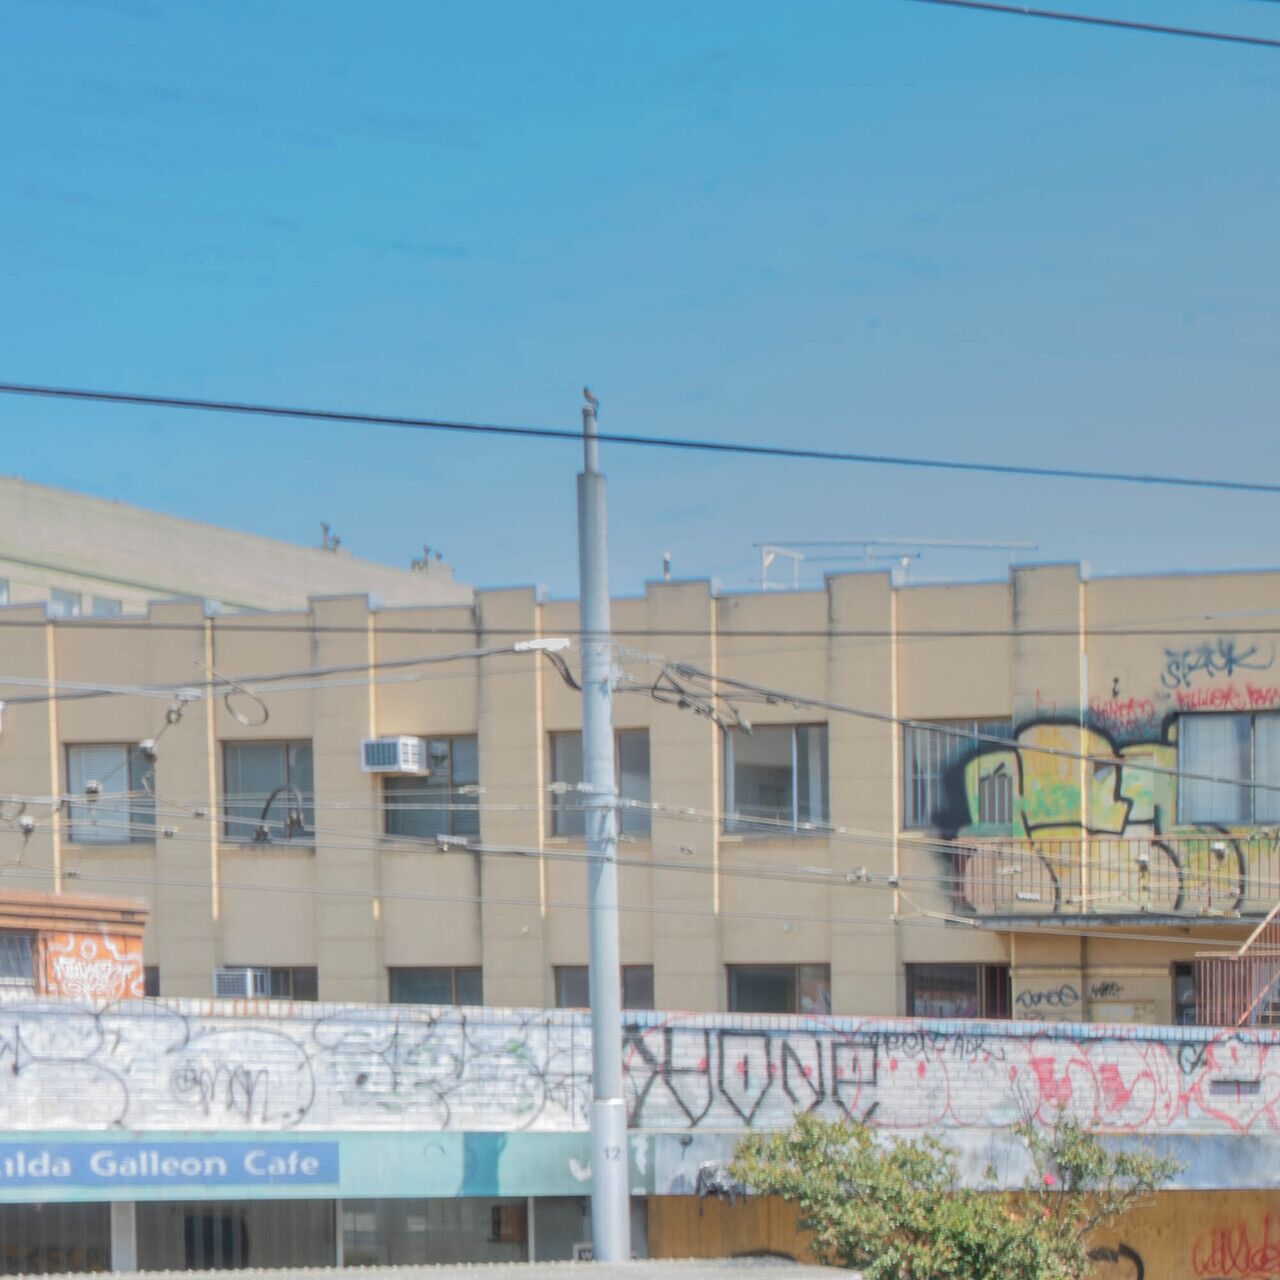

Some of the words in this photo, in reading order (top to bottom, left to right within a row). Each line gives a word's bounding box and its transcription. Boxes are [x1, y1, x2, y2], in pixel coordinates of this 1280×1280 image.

[0, 1151, 71, 1178] ilda
[90, 1149, 227, 1178] Galleon
[243, 1149, 319, 1176] Cafe
[605, 1148, 621, 1162] 12
